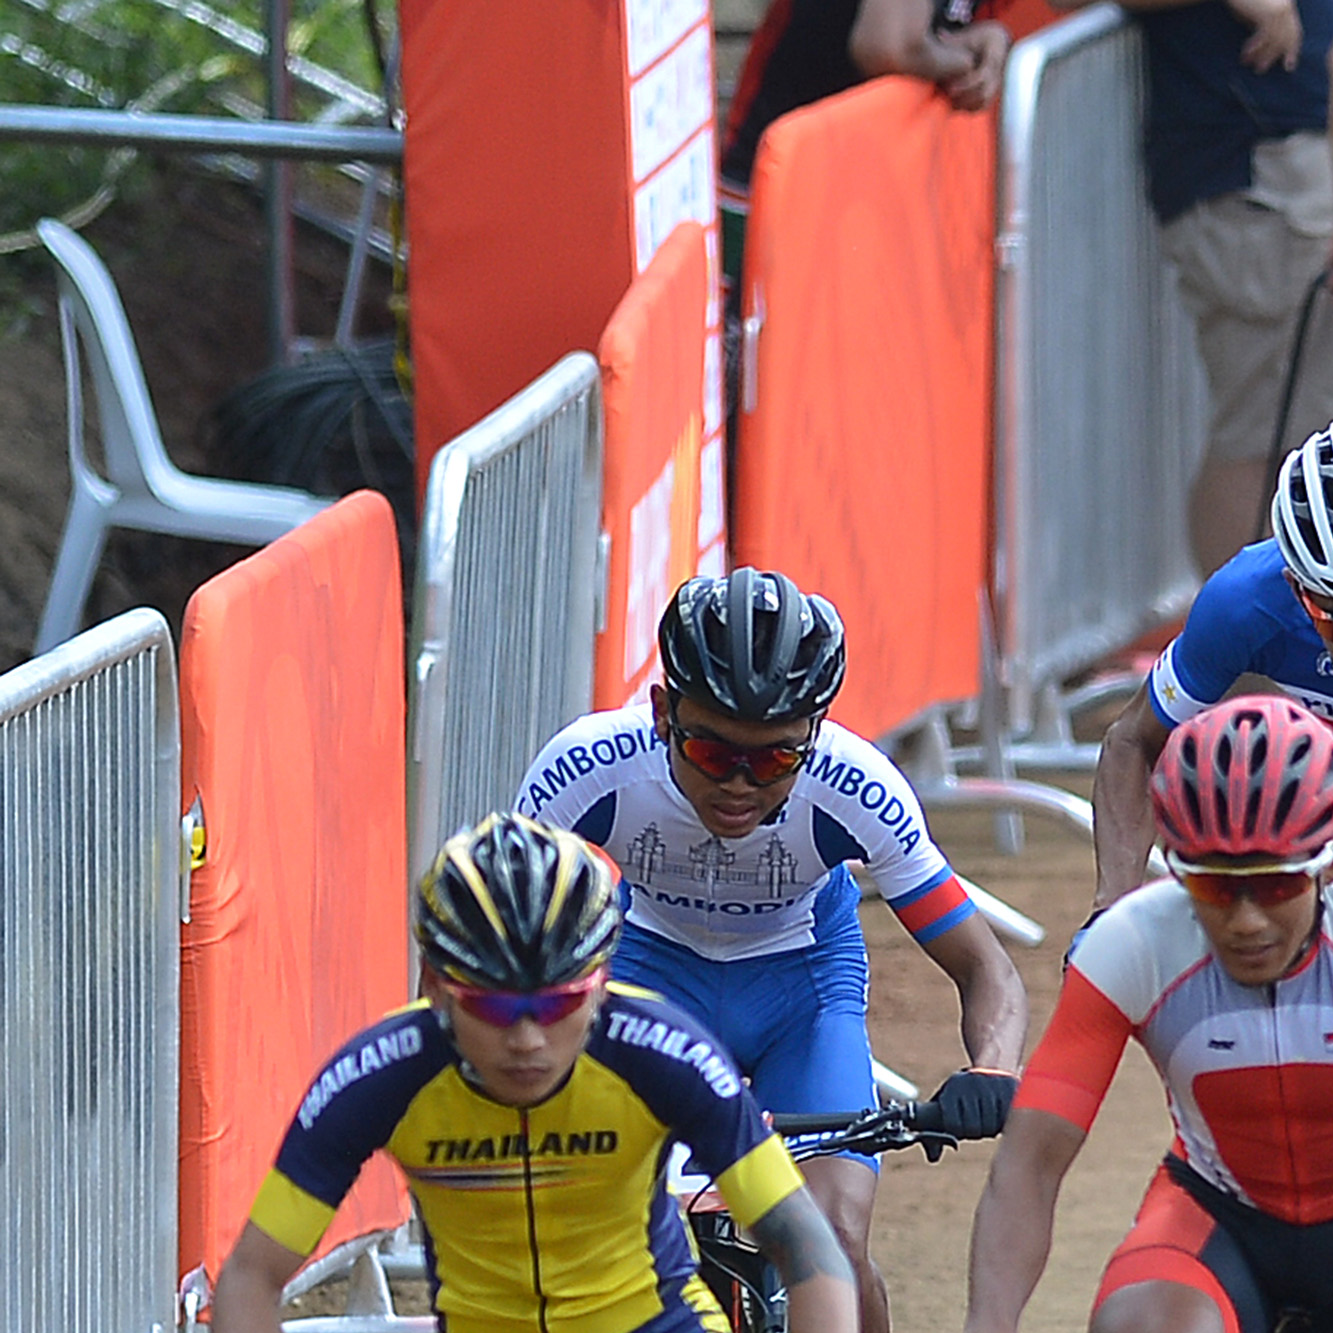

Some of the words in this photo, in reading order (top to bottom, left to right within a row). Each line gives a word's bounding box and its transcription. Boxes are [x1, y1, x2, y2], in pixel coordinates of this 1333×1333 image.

[804, 749, 921, 855] AMBODIA
[298, 1025, 422, 1131] THAILAND
[606, 1011, 741, 1098] THAILAND
[425, 1130, 618, 1163] THAILAND
